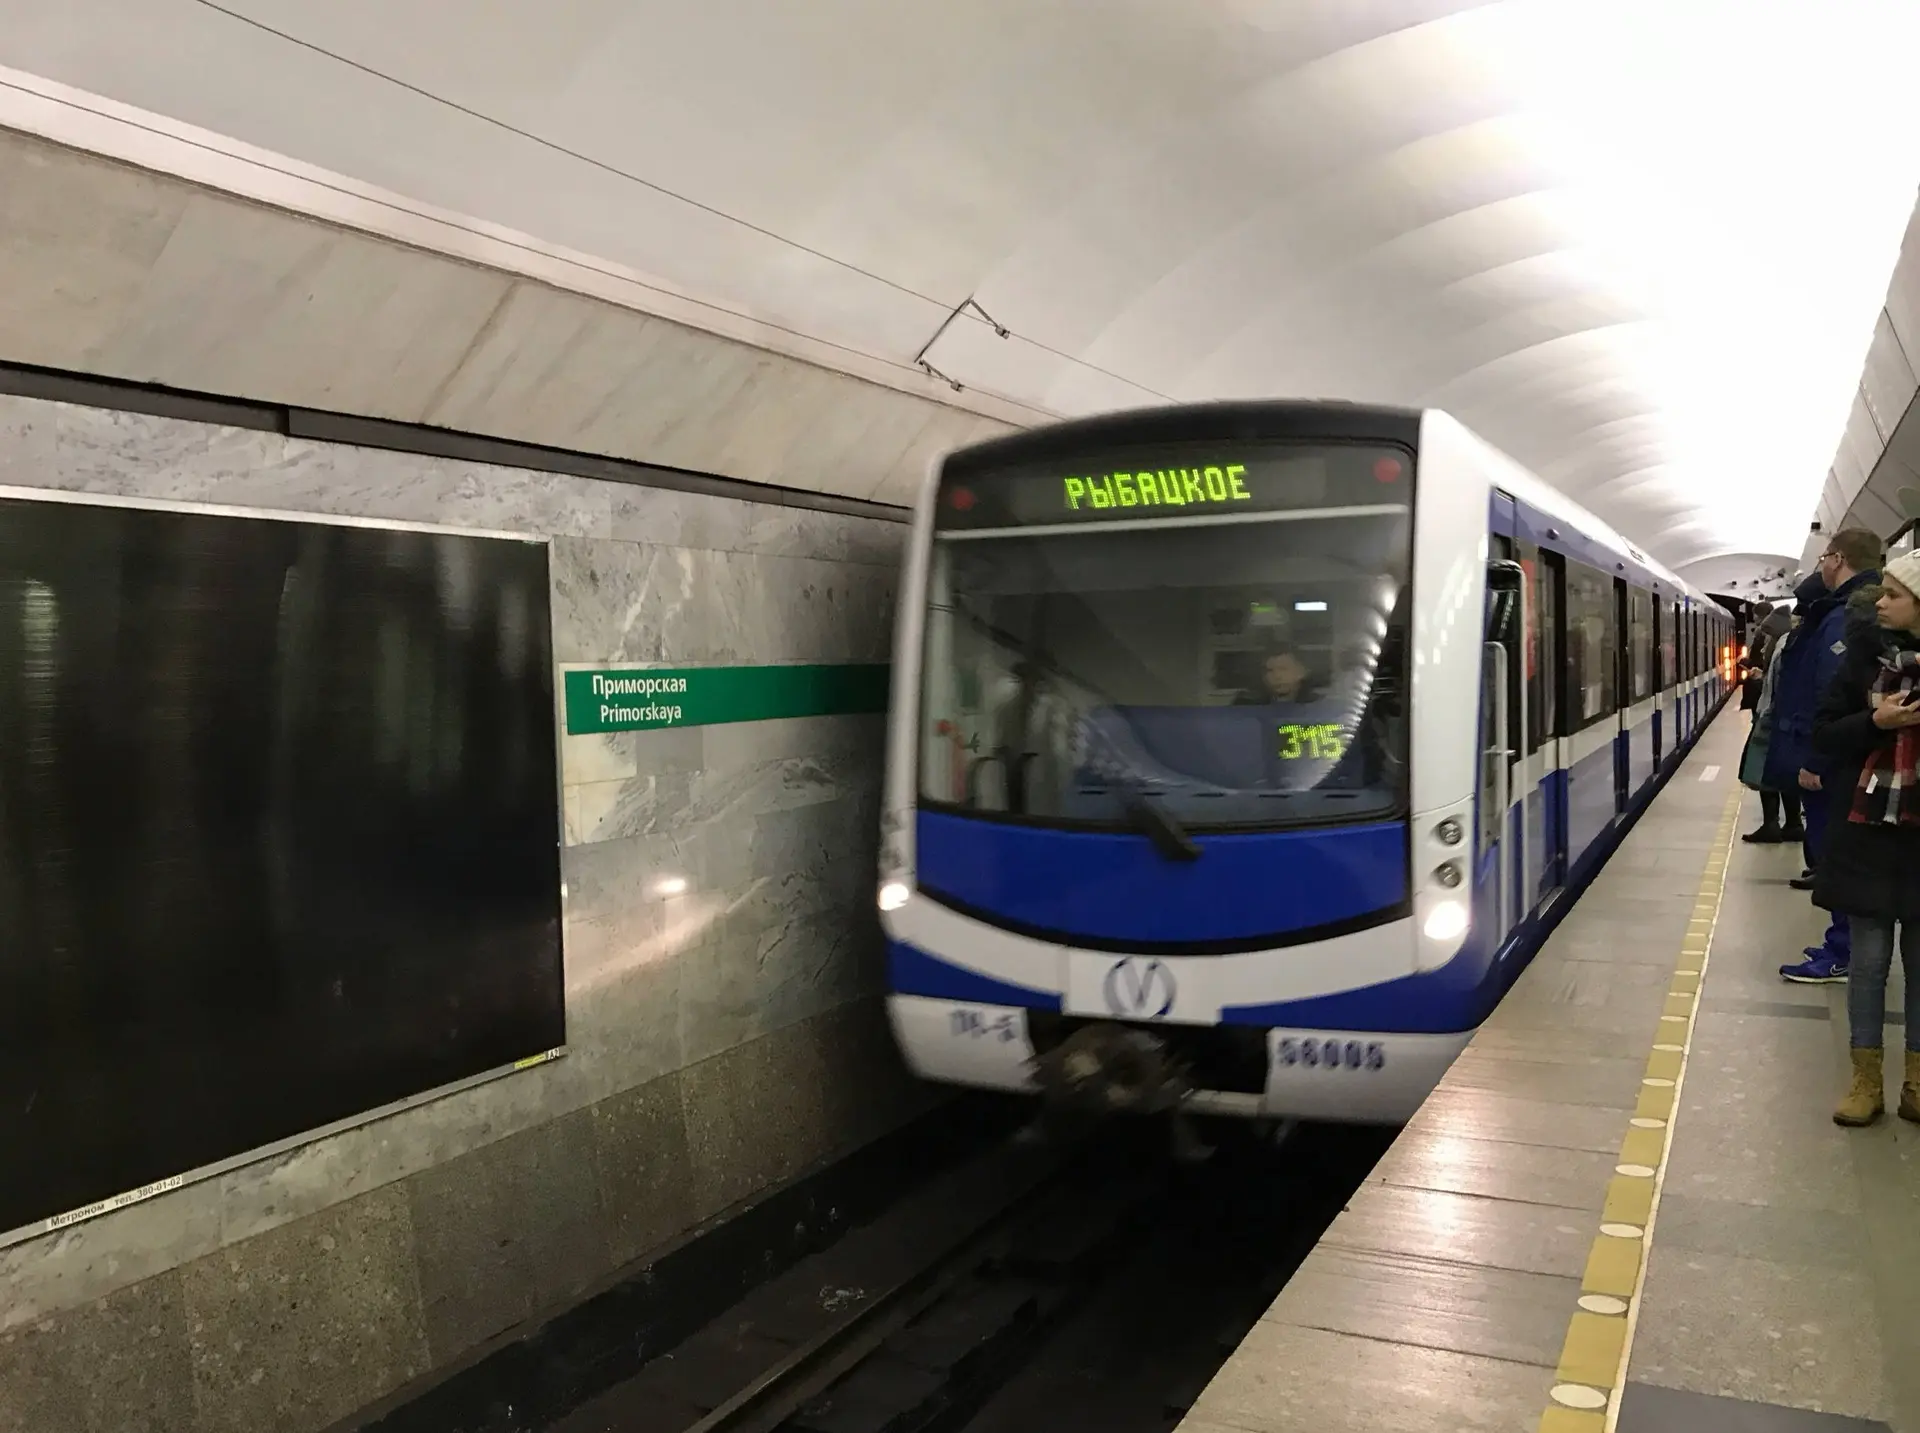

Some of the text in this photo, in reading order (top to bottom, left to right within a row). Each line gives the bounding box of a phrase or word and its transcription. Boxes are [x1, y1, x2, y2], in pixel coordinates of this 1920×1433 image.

[1064, 465, 1251, 510] РЫБАЦКОЕ
[592, 675, 687, 700] Приморская
[600, 702, 682, 724] Primorskaya
[1279, 724, 1344, 759] 315
[50, 1203, 105, 1228] Метроном
